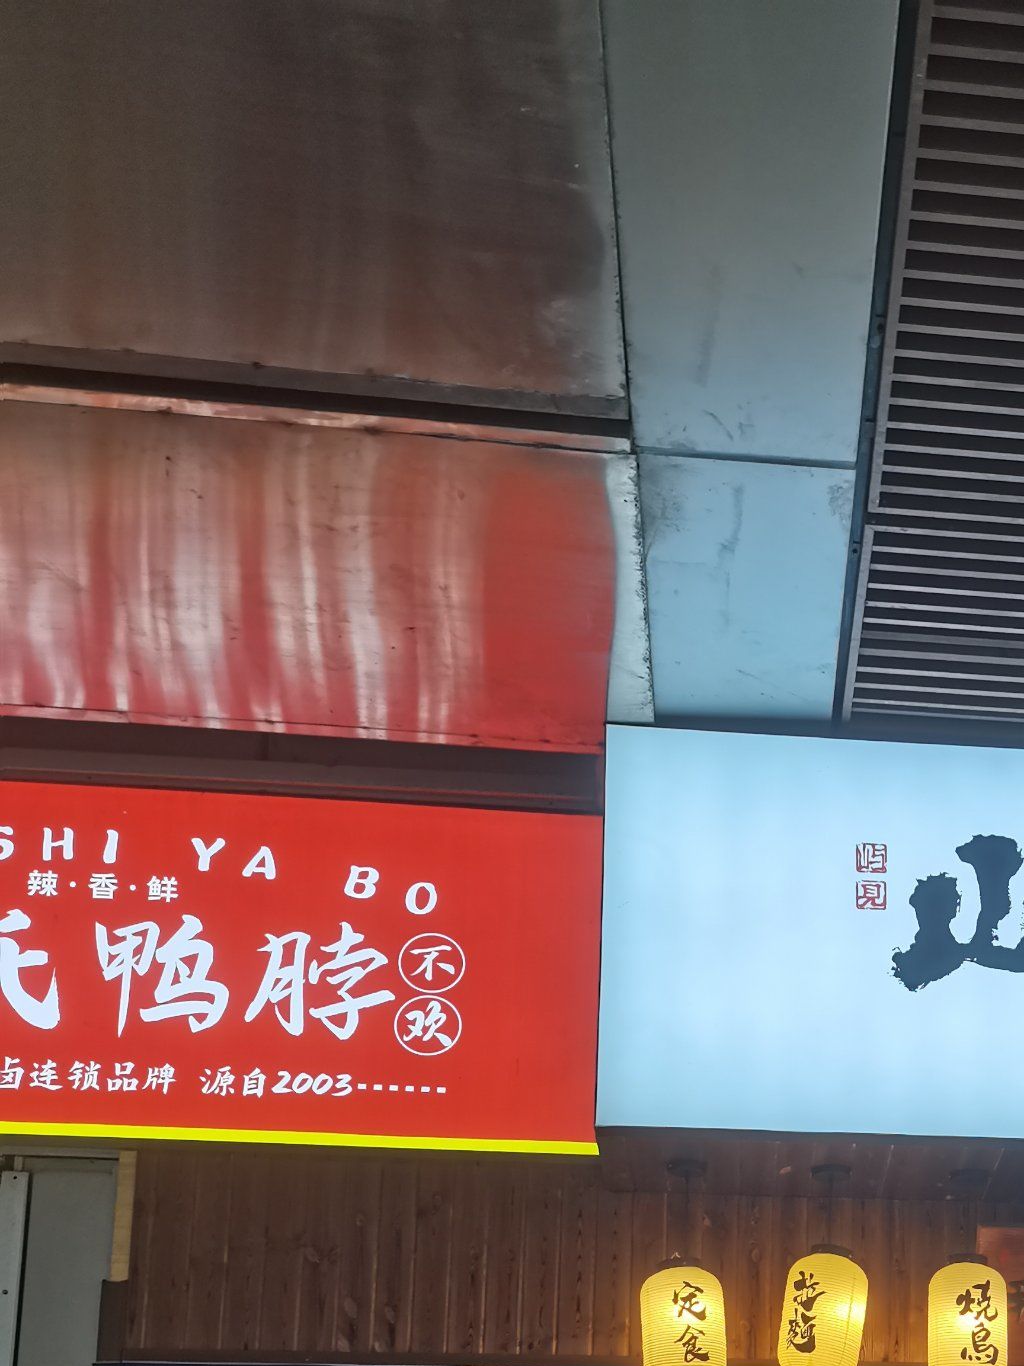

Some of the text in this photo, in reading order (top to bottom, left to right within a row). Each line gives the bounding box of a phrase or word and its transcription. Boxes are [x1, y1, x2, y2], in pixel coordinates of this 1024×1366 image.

[191, 837, 276, 881] YA
[344, 865, 438, 916] BO
[672, 1281, 711, 1363] 定食
